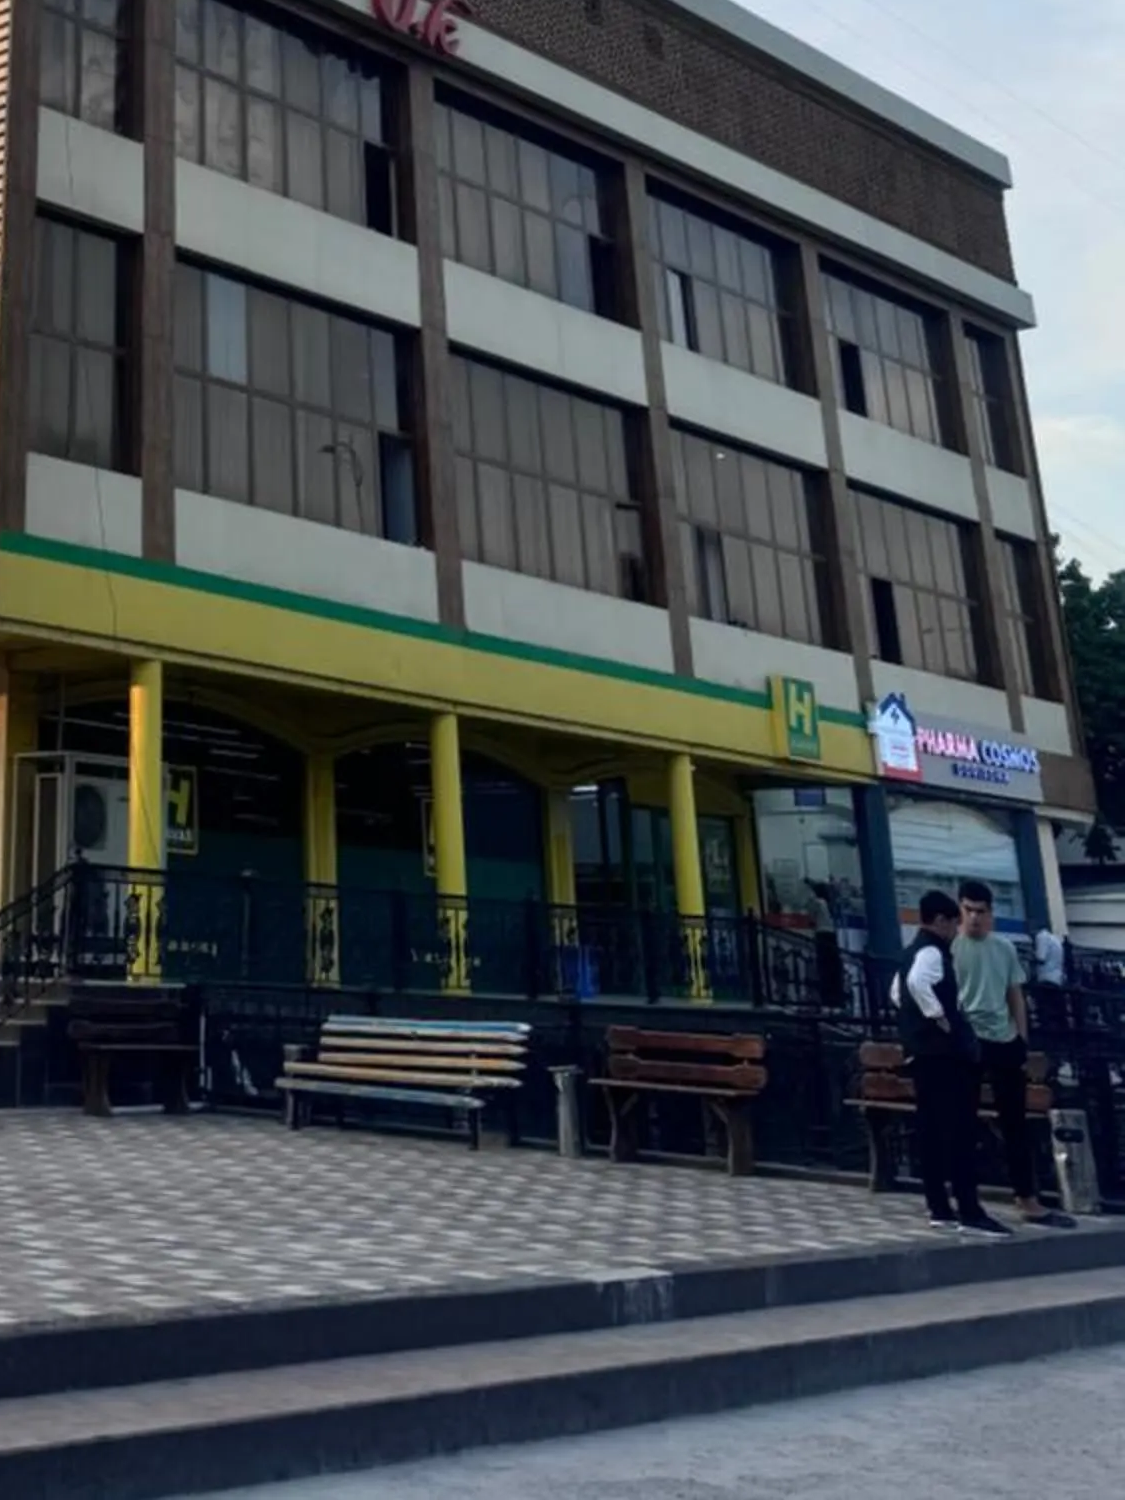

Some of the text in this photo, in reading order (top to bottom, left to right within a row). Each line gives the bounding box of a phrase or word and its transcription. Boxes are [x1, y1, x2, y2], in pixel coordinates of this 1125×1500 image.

[789, 682, 813, 737] H
[916, 727, 979, 763] PHARMA
[978, 739, 1041, 773] COSMOS
